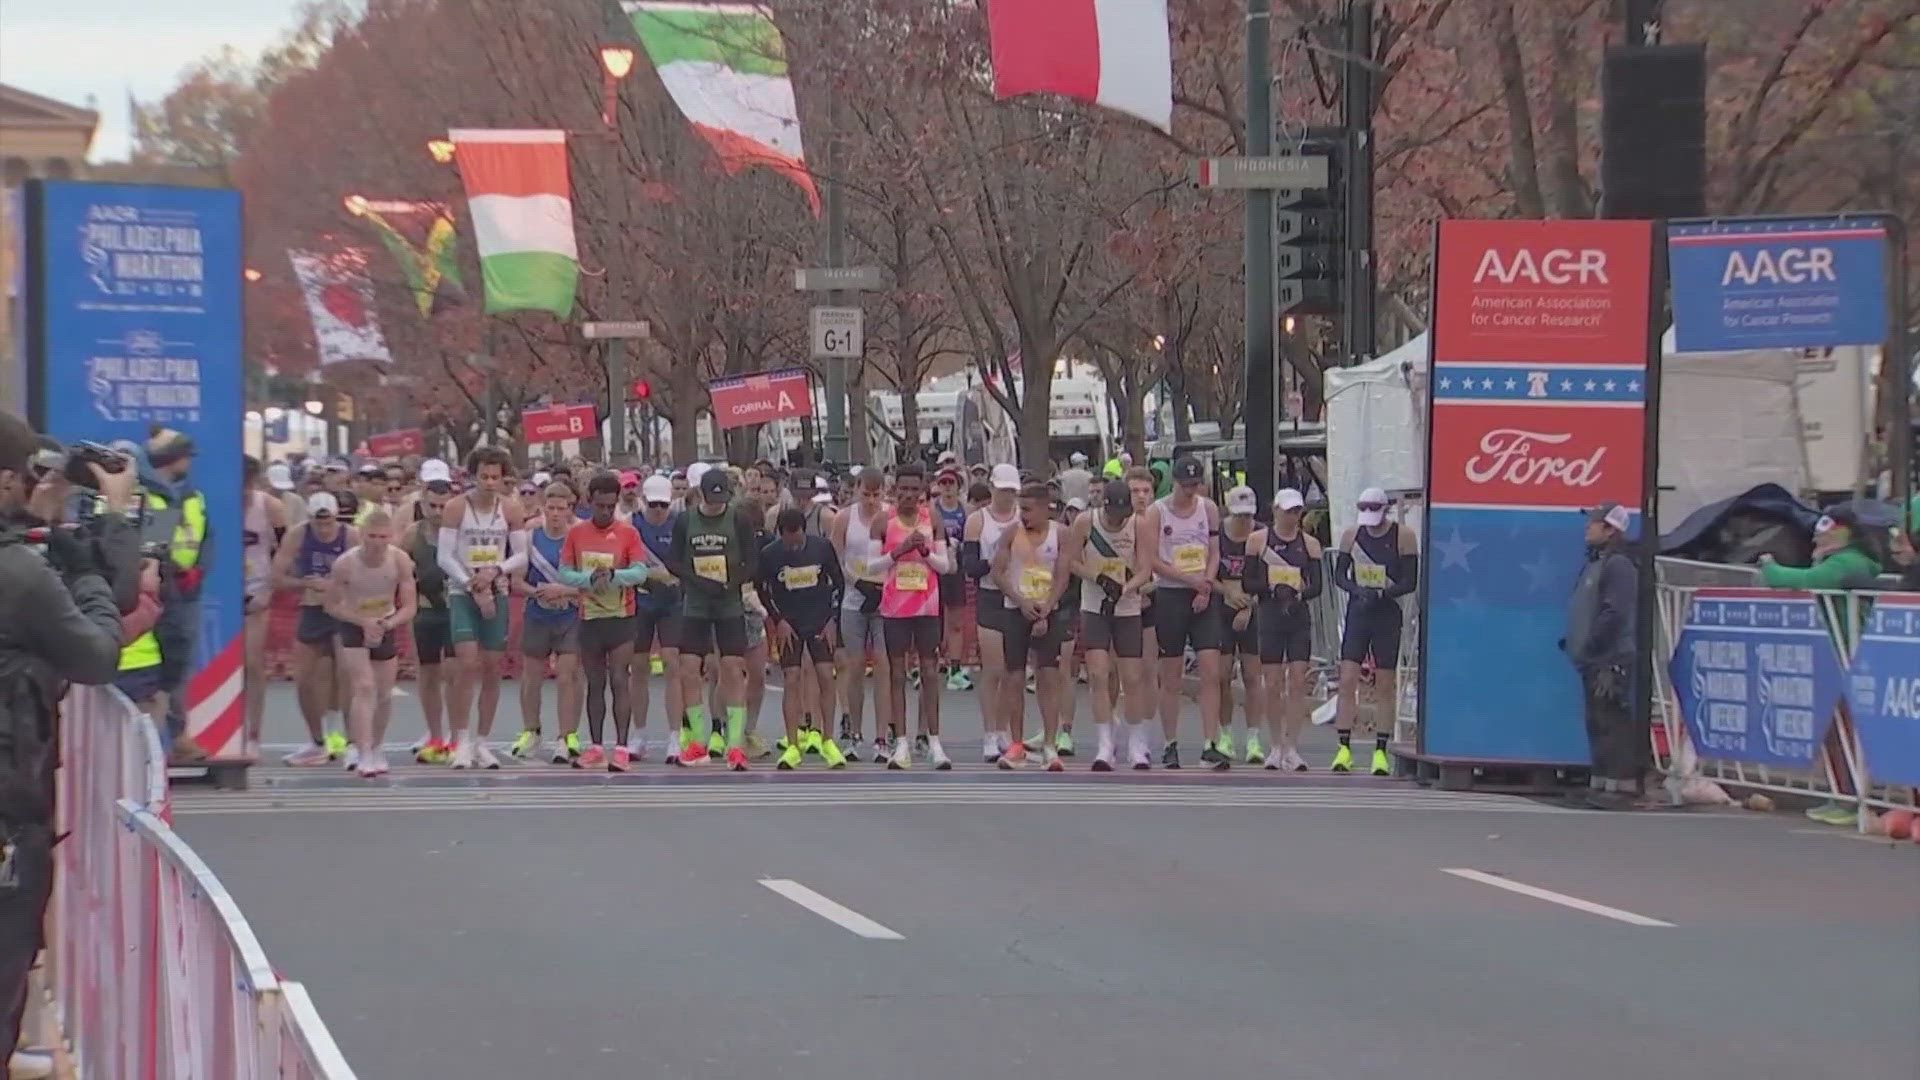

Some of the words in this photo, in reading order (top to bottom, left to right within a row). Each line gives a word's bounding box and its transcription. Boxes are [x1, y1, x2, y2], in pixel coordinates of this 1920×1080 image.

[1234, 159, 1310, 172] INDONESIA
[87, 222, 203, 253] PHILADELPHIA
[823, 268, 864, 279] IRELAND
[1472, 248, 1609, 285] AACR
[1721, 247, 1837, 286] AACR
[1471, 296, 1532, 309] American
[1537, 296, 1612, 310] Association
[1723, 298, 1777, 310] American
[1778, 295, 1839, 308] Association
[1471, 313, 1489, 326] for
[1492, 312, 1537, 326] Cancer
[1741, 313, 1780, 327] Cancer
[824, 328, 851, 352] G-1
[89, 356, 200, 382] PHILADELPHIA
[732, 400, 775, 415] CORRAL
[777, 390, 796, 413] A
[569, 416, 584, 434] B
[1465, 428, 1608, 487] Ford
